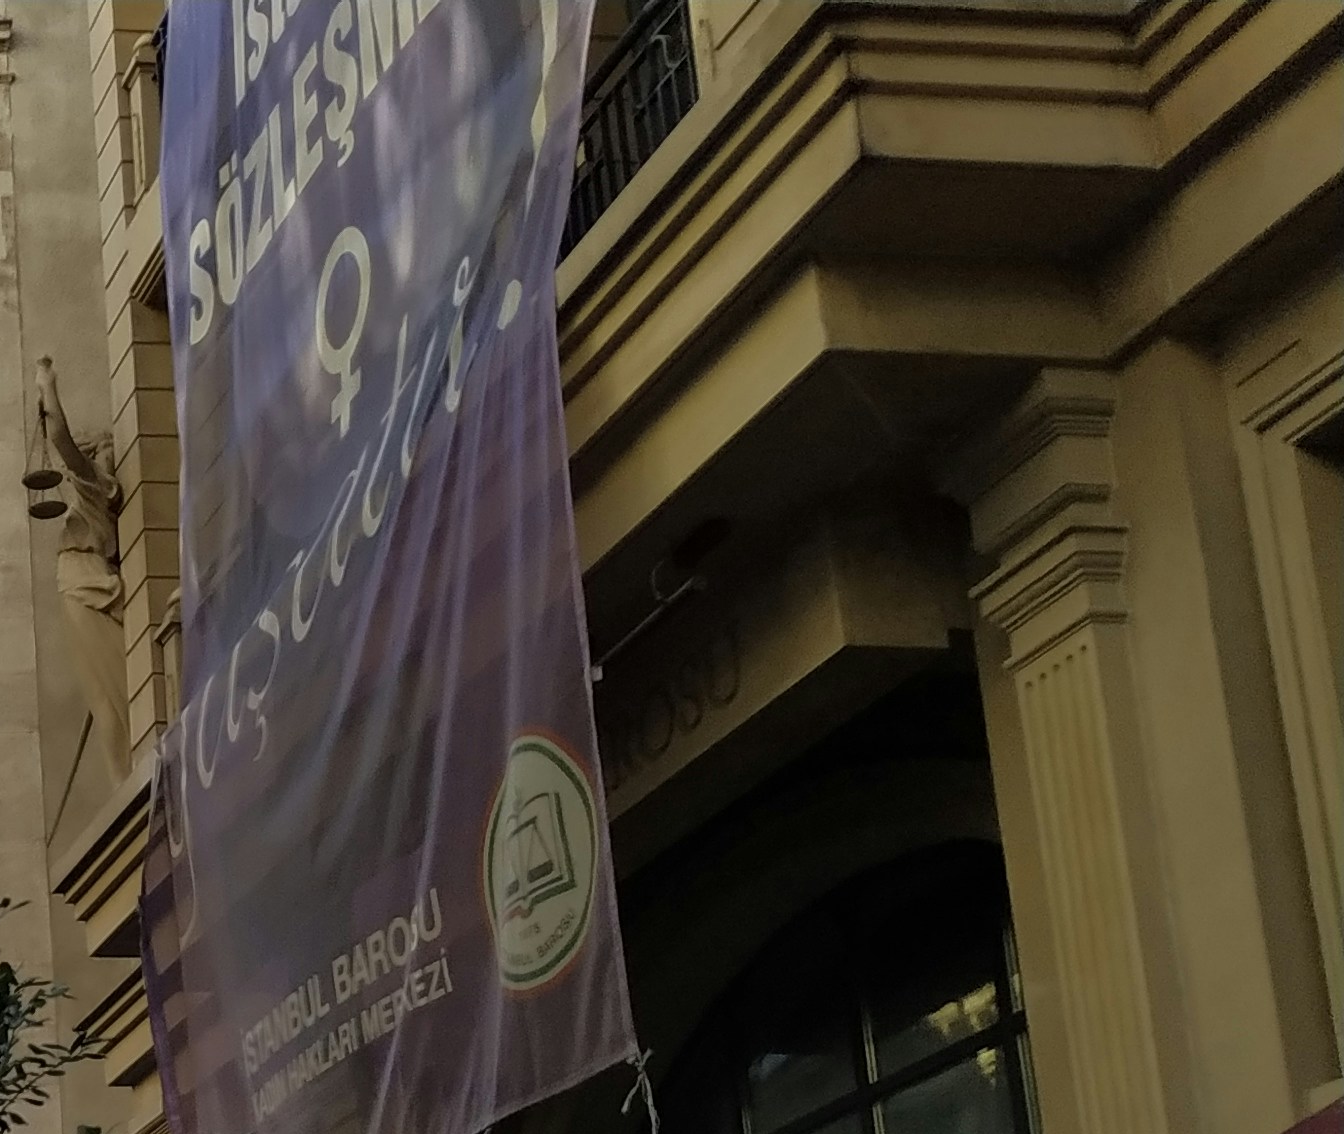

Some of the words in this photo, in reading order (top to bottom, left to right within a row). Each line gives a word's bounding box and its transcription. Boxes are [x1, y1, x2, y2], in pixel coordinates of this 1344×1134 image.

[188, 0, 442, 346] SÖZLEŞM
[240, 974, 331, 1079] İSTANBUL
[332, 887, 443, 1005] BAROSU
